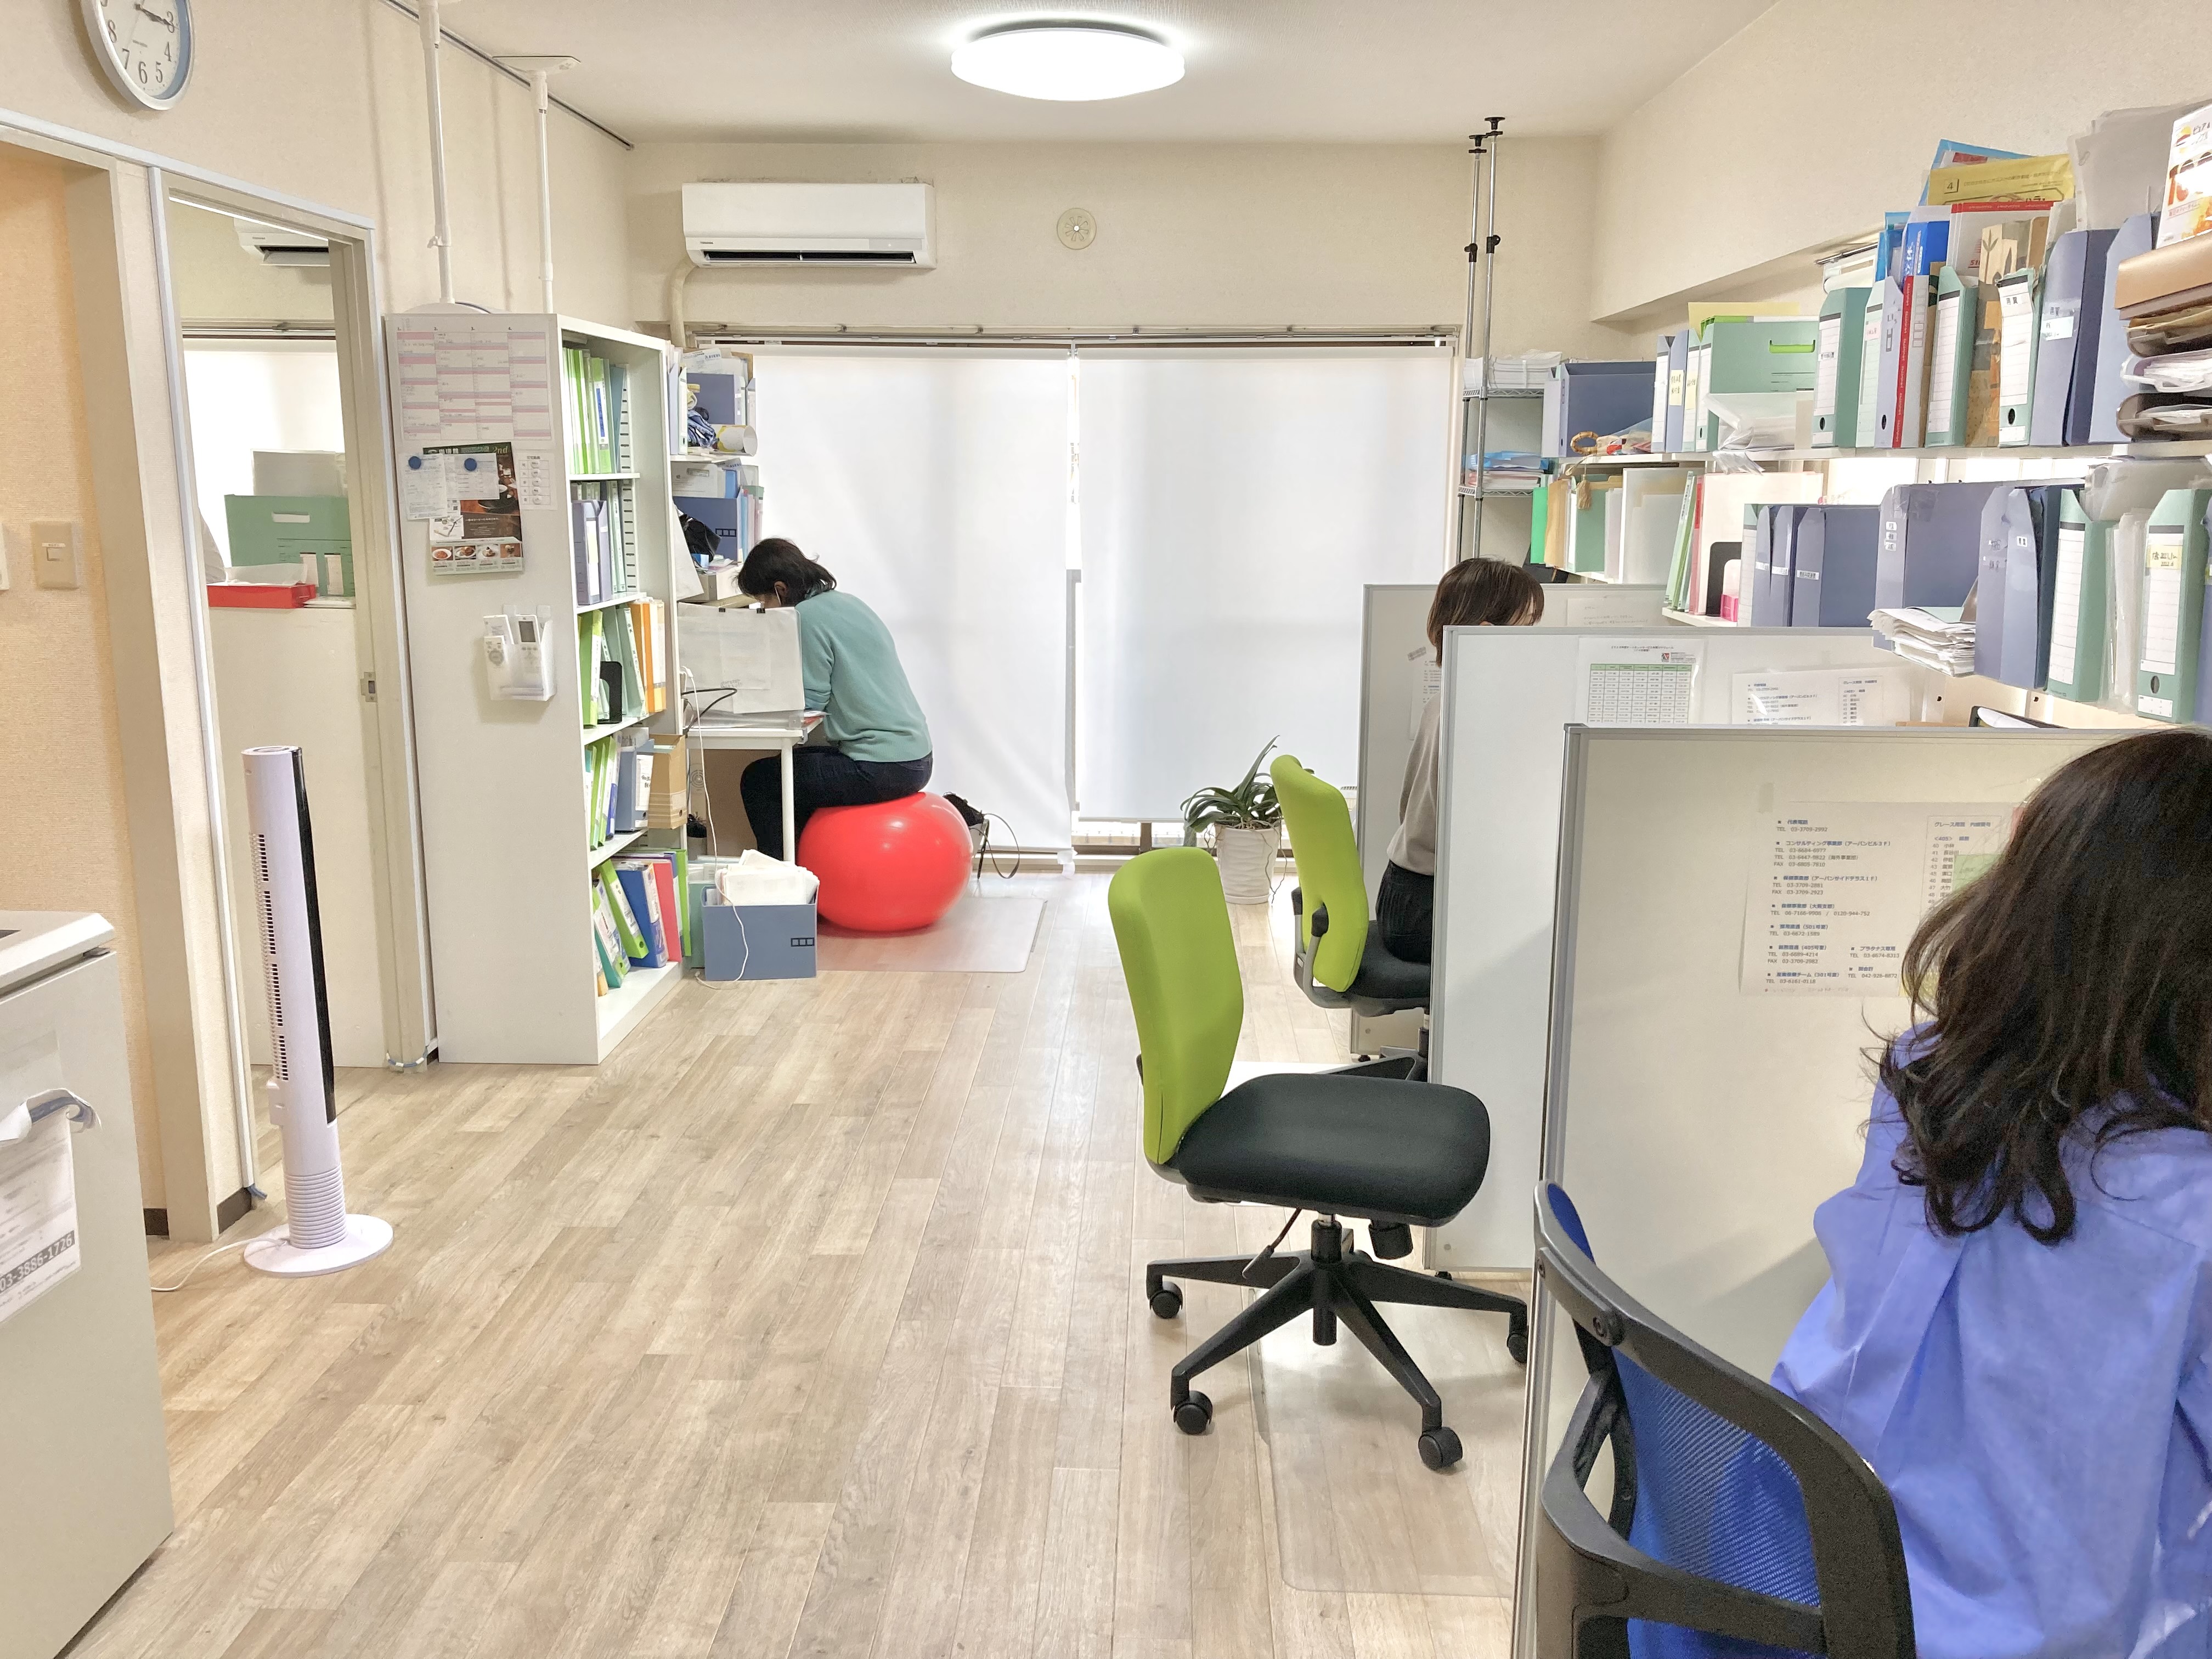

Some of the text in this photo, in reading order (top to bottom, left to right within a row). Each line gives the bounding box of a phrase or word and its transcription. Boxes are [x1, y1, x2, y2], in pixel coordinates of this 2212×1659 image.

[122, 48, 130, 70] 7
[164, 41, 172, 63] 4
[138, 61, 148, 84] 6
[155, 61, 163, 83] 5
[1946, 182, 1954, 190] 4
